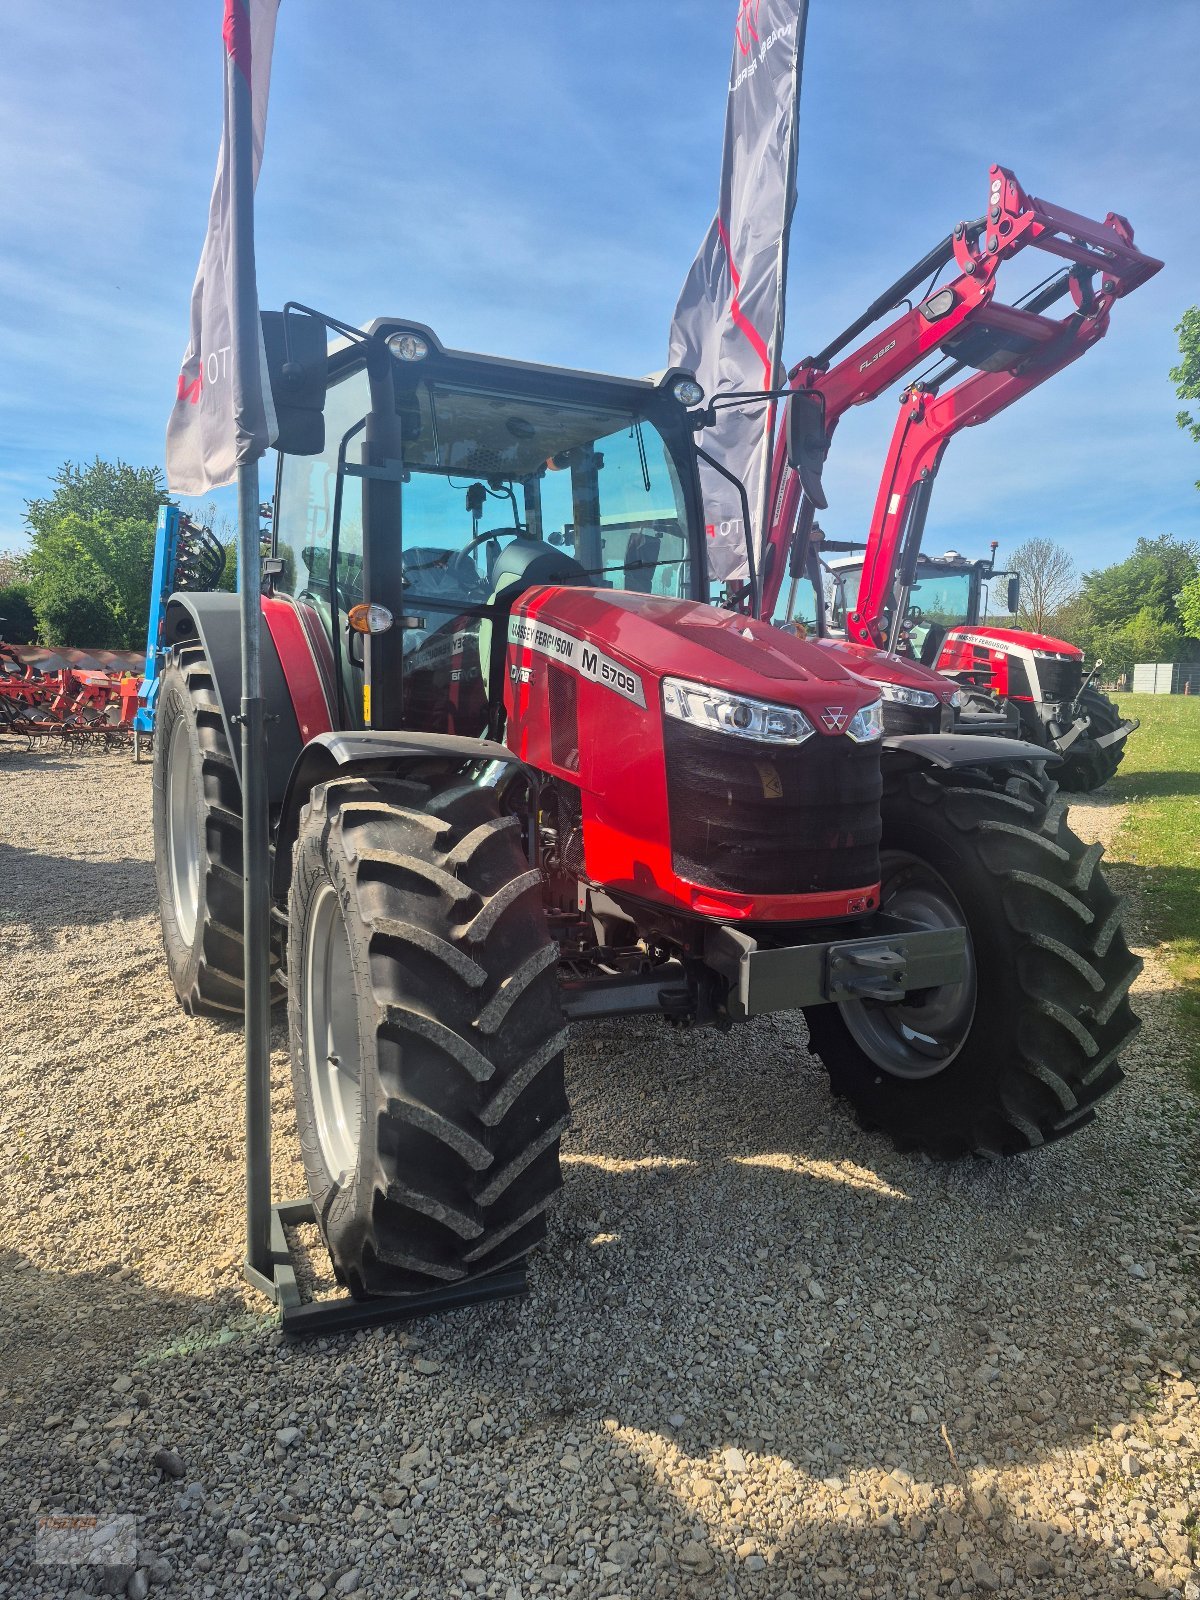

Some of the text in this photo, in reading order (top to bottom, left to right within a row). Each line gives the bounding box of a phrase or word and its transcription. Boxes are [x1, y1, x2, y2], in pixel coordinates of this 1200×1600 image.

[511, 623, 636, 695] MASSEY FERGUSON M 5709
[979, 637, 1010, 651] FERGUSON
